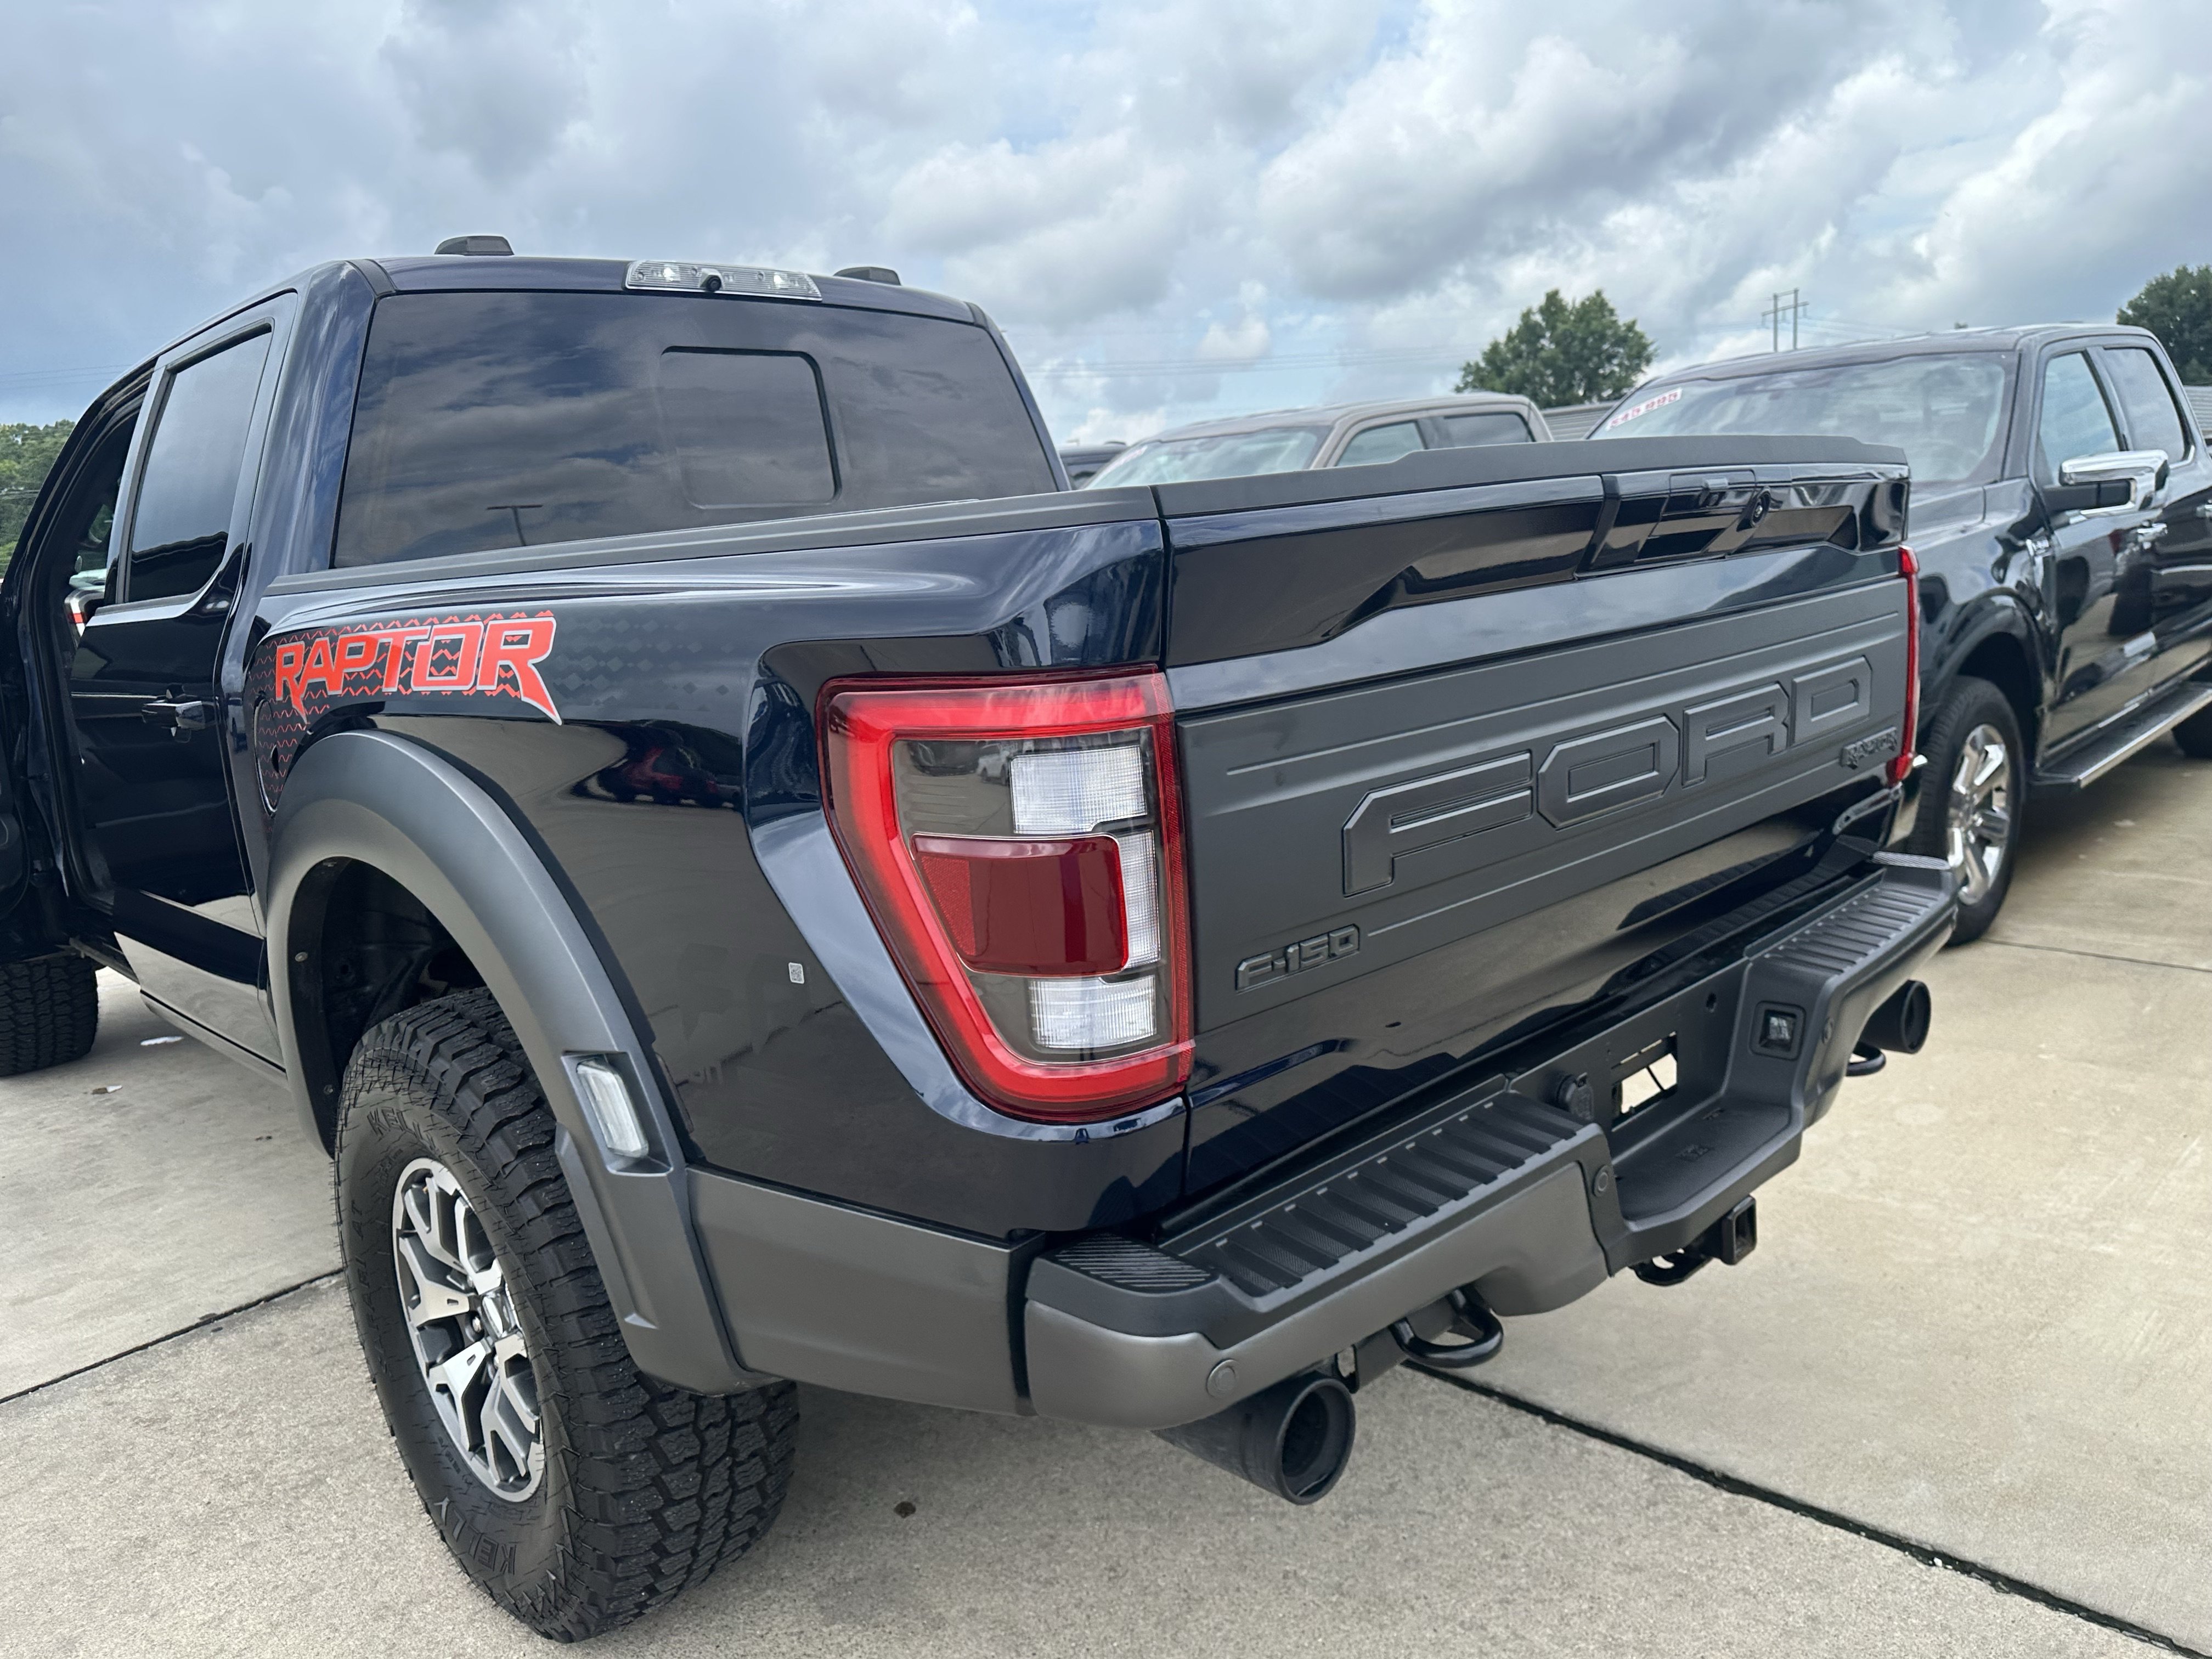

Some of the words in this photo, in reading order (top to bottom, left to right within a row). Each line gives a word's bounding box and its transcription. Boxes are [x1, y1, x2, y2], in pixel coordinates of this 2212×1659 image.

[275, 617, 562, 726] RAPTOR
[1342, 654, 1872, 898] FORD
[1235, 923, 1360, 991] F-150
[433, 1497, 516, 1576] KELLY
